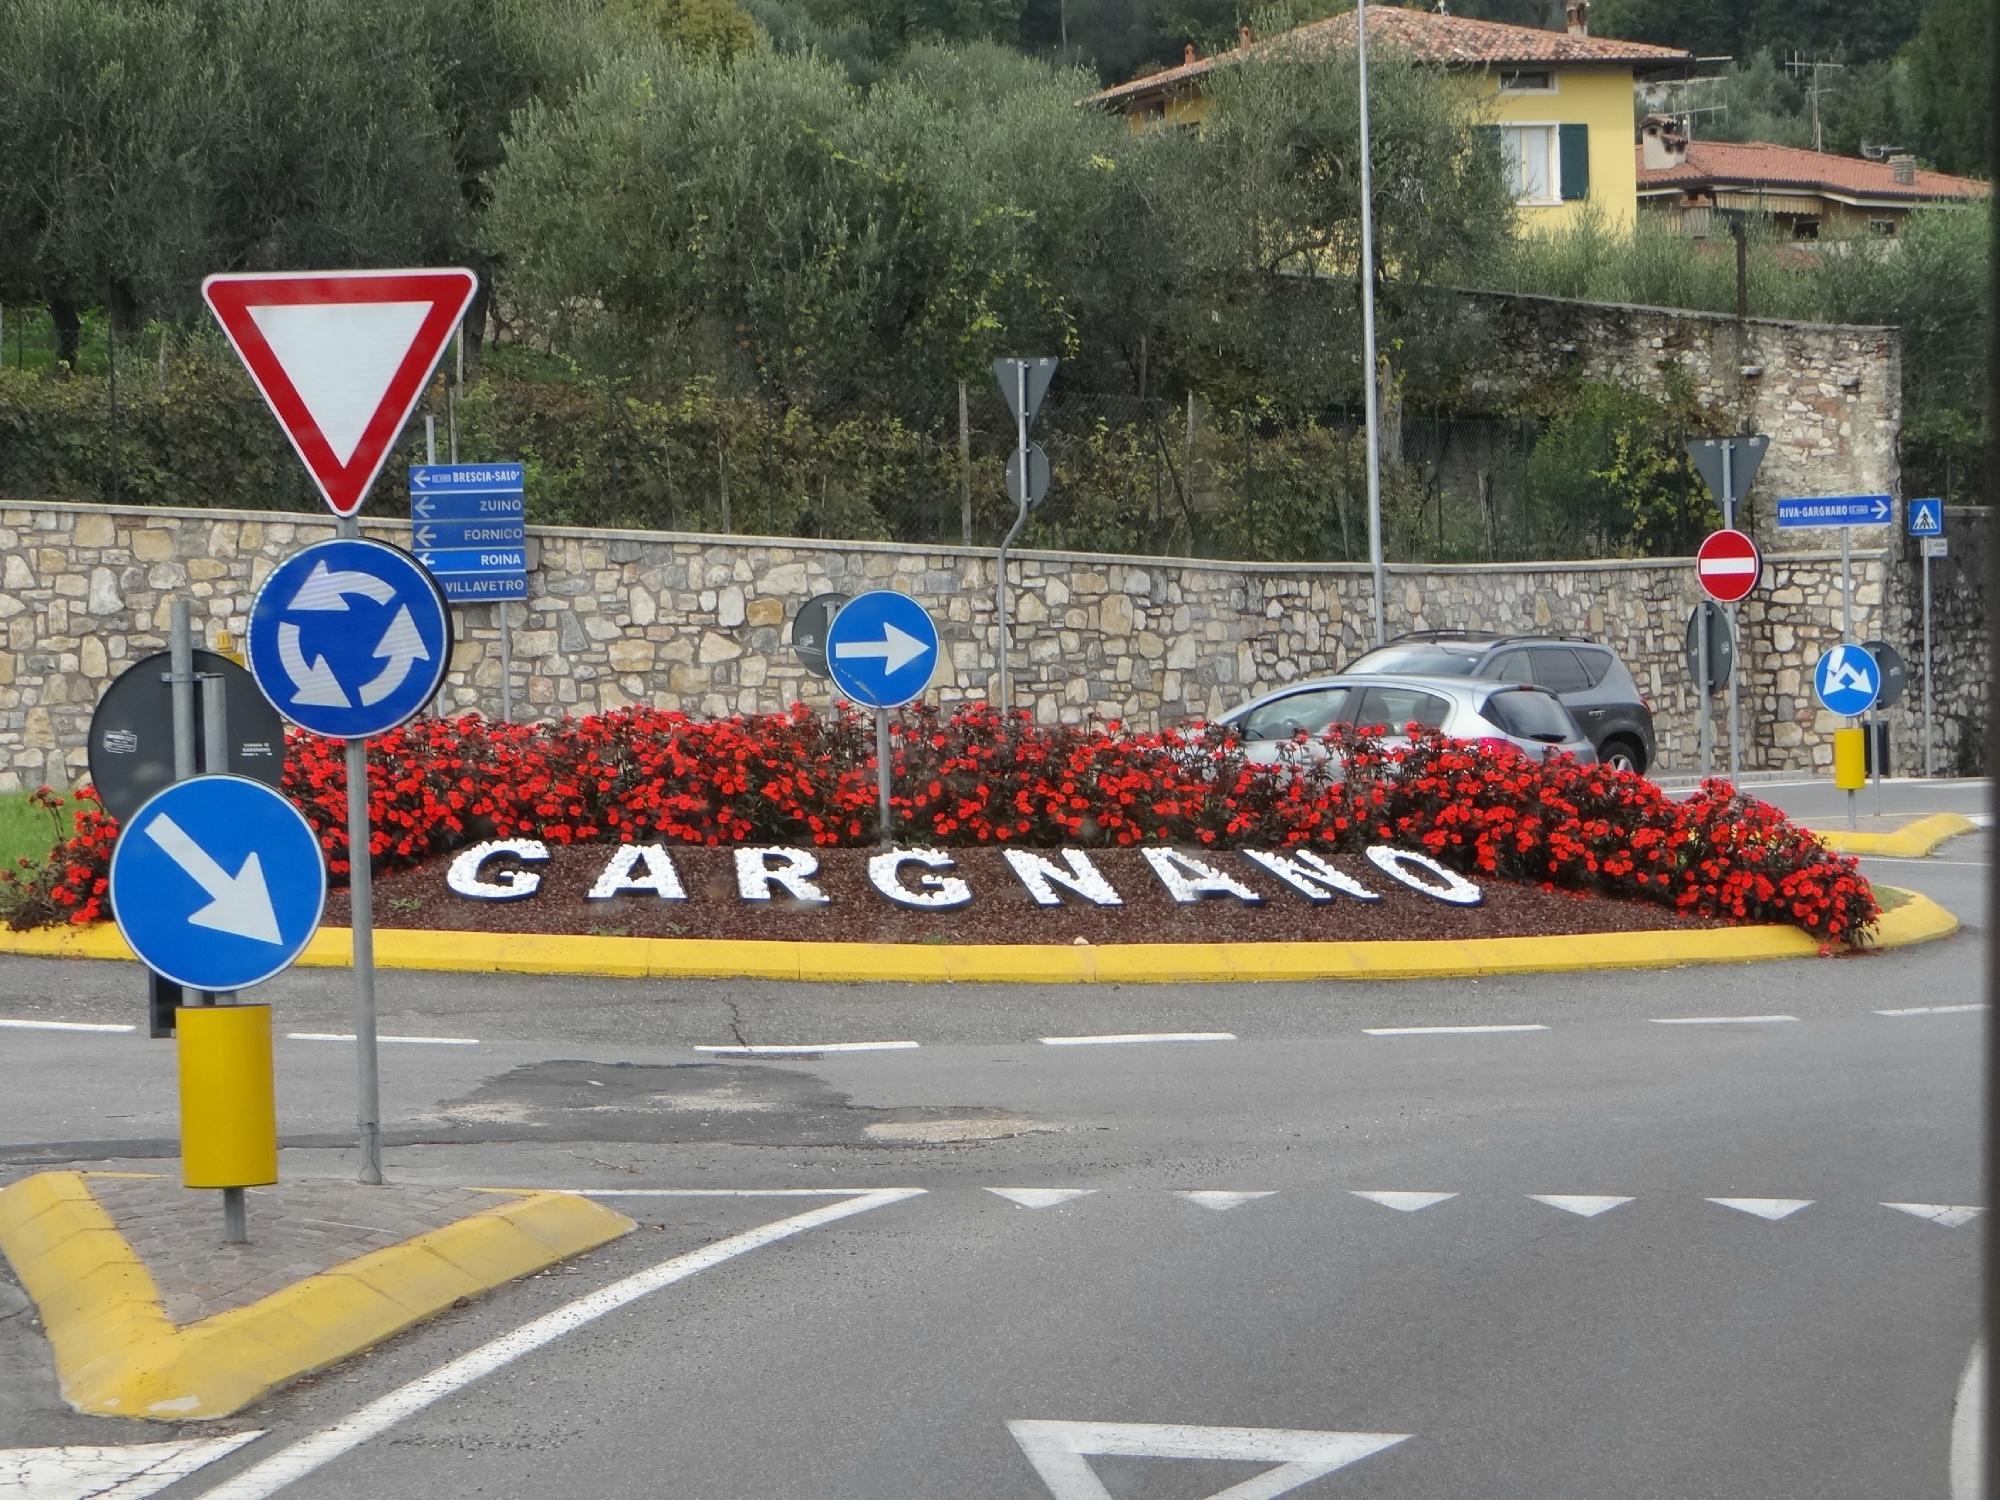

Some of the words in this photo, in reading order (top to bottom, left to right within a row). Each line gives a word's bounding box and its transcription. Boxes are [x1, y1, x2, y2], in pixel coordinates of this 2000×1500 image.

[480, 500, 521, 511] ZUINO
[464, 528, 523, 541] FORNICO
[481, 554, 521, 566] ROINA
[445, 580, 524, 593] VILLAVETRO
[445, 837, 1484, 913] GARGNANO
